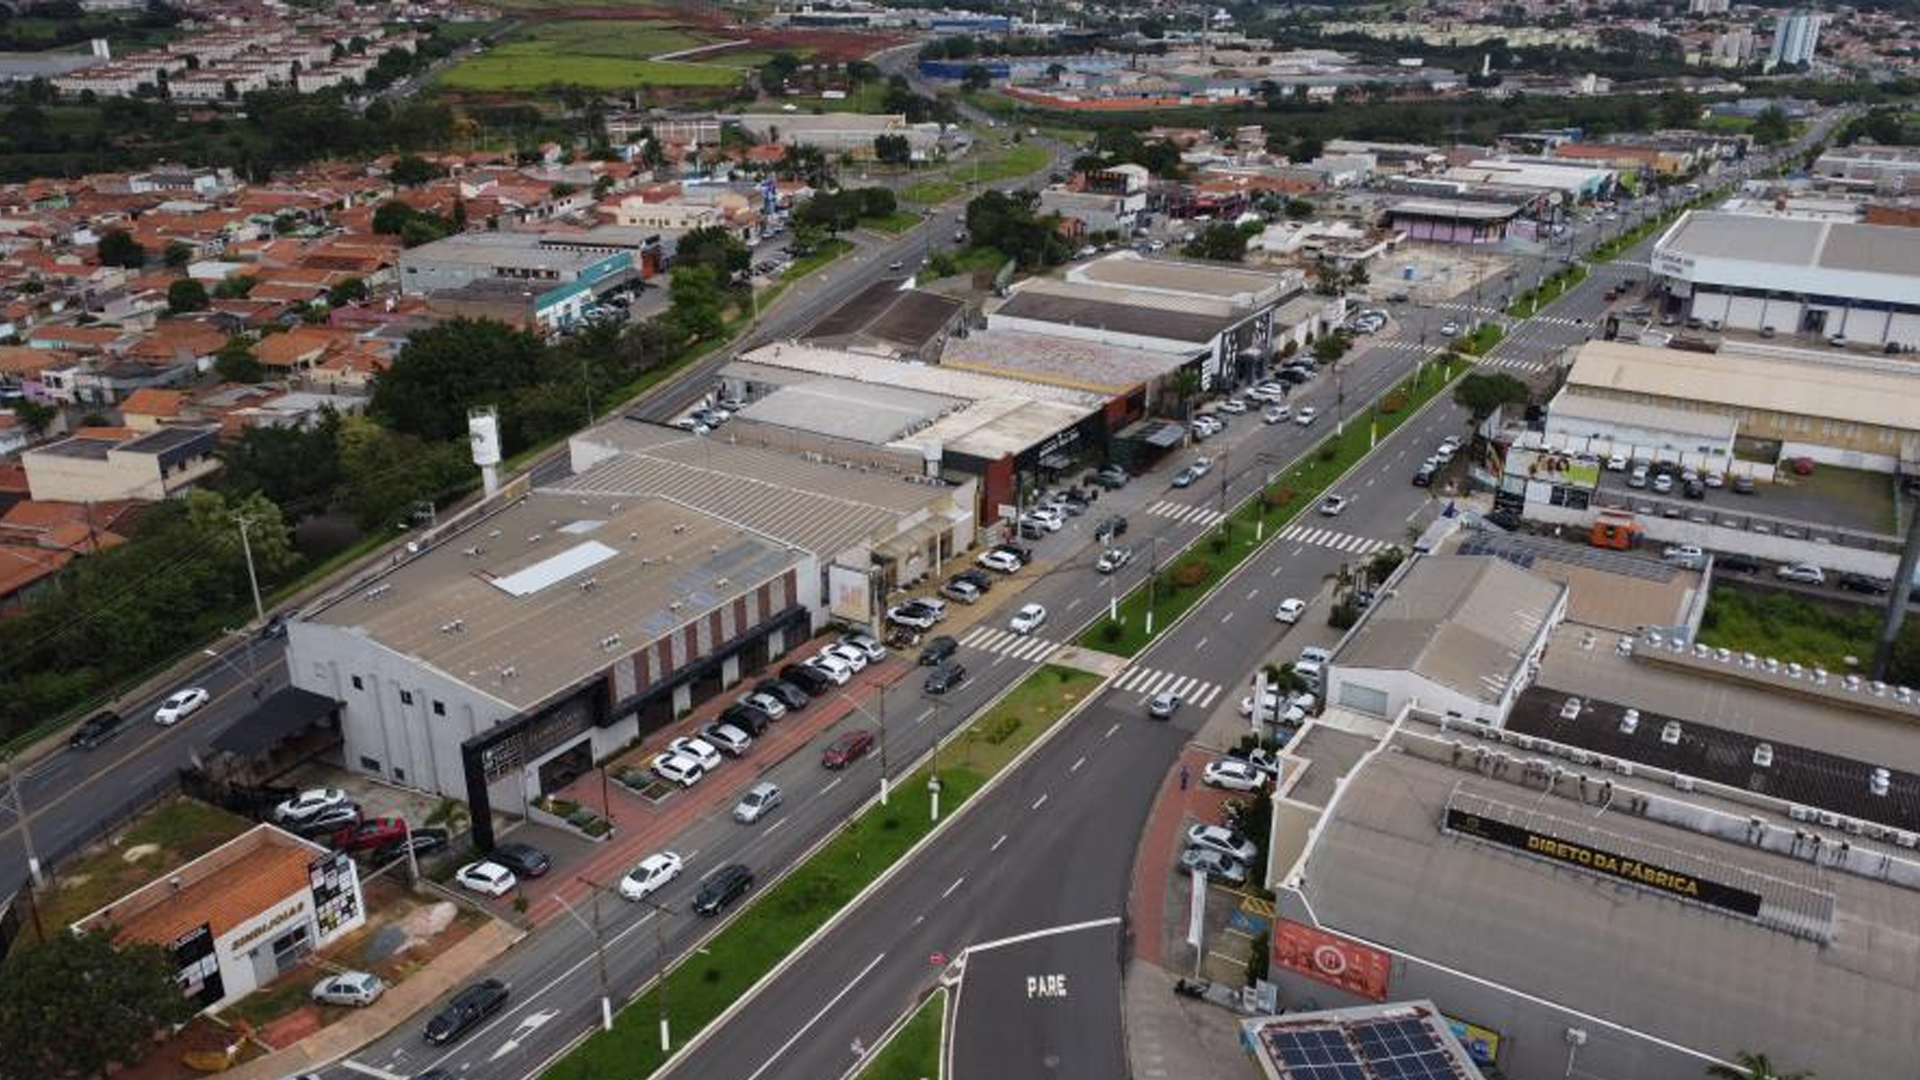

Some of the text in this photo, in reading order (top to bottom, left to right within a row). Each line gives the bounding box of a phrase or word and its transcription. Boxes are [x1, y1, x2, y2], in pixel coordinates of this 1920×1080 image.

[1529, 836, 1698, 895] DIRETO DA FÁBRICA
[1027, 974, 1067, 998] PARE
